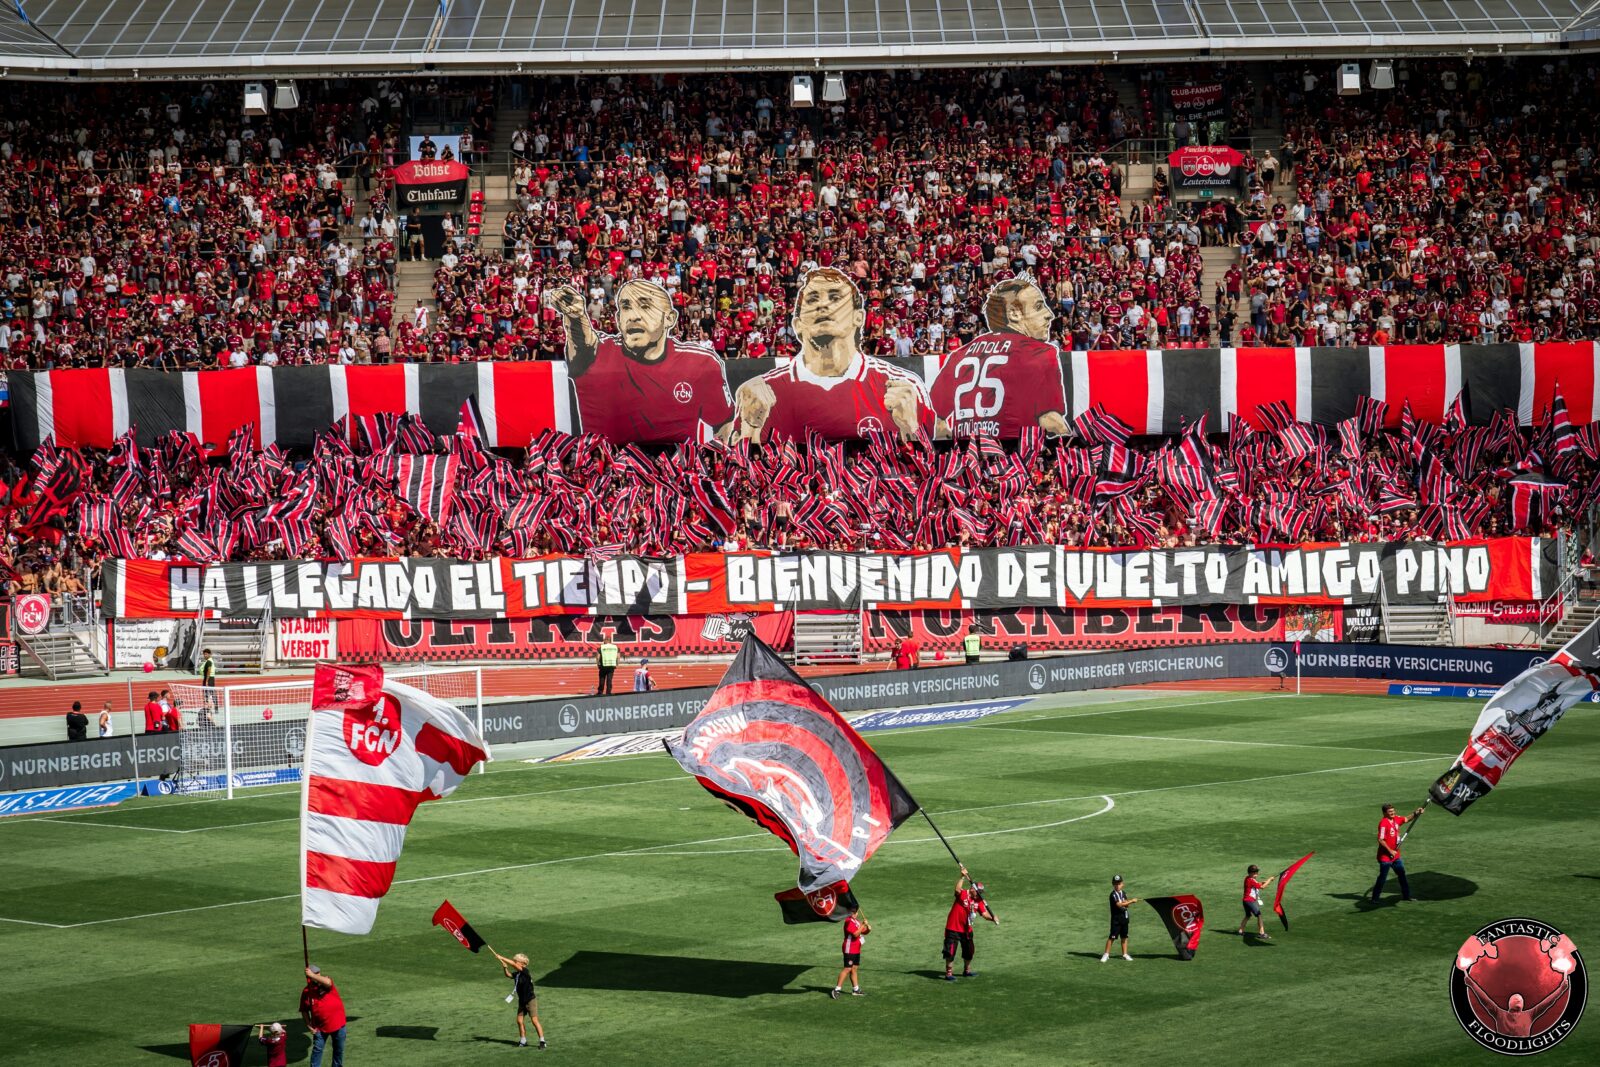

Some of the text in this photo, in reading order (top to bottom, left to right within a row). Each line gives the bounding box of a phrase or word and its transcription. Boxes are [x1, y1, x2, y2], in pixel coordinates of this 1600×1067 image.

[413, 164, 450, 178] Böhse
[1197, 163, 1213, 171] FCN
[1182, 177, 1231, 186] Leutershausen
[407, 189, 457, 202] Clubfanz
[965, 340, 1011, 355] PINOLA
[675, 390, 692, 398] FCN
[954, 355, 1009, 420] 25
[170, 566, 231, 609] HA
[243, 562, 437, 609] LLEGADO
[450, 561, 505, 610] EL
[514, 559, 669, 608] TIEMPO
[728, 553, 982, 602] BIENVENIDO
[998, 551, 1050, 598] DE
[1066, 550, 1229, 599] VUELTO
[1242, 549, 1381, 595] AMIGO
[1396, 547, 1490, 594] PINO
[23, 611, 42, 623] FCN
[1355, 608, 1372, 617] YOU
[281, 617, 329, 634] STADION
[1346, 617, 1365, 626] WILL
[281, 640, 330, 658] VERBOT
[1050, 655, 1224, 681] NÜRNBERGER VERSICHERUNG
[1295, 653, 1493, 674] NÜRNBERGER VERSICHERUNG
[829, 674, 1000, 701] NÜRNBERGER VERSICHERUNG
[373, 696, 389, 725] 1.
[585, 702, 674, 723] NÜRNBERGER
[350, 723, 398, 754] FCN
[11, 751, 122, 777] NÜRNBERGER
